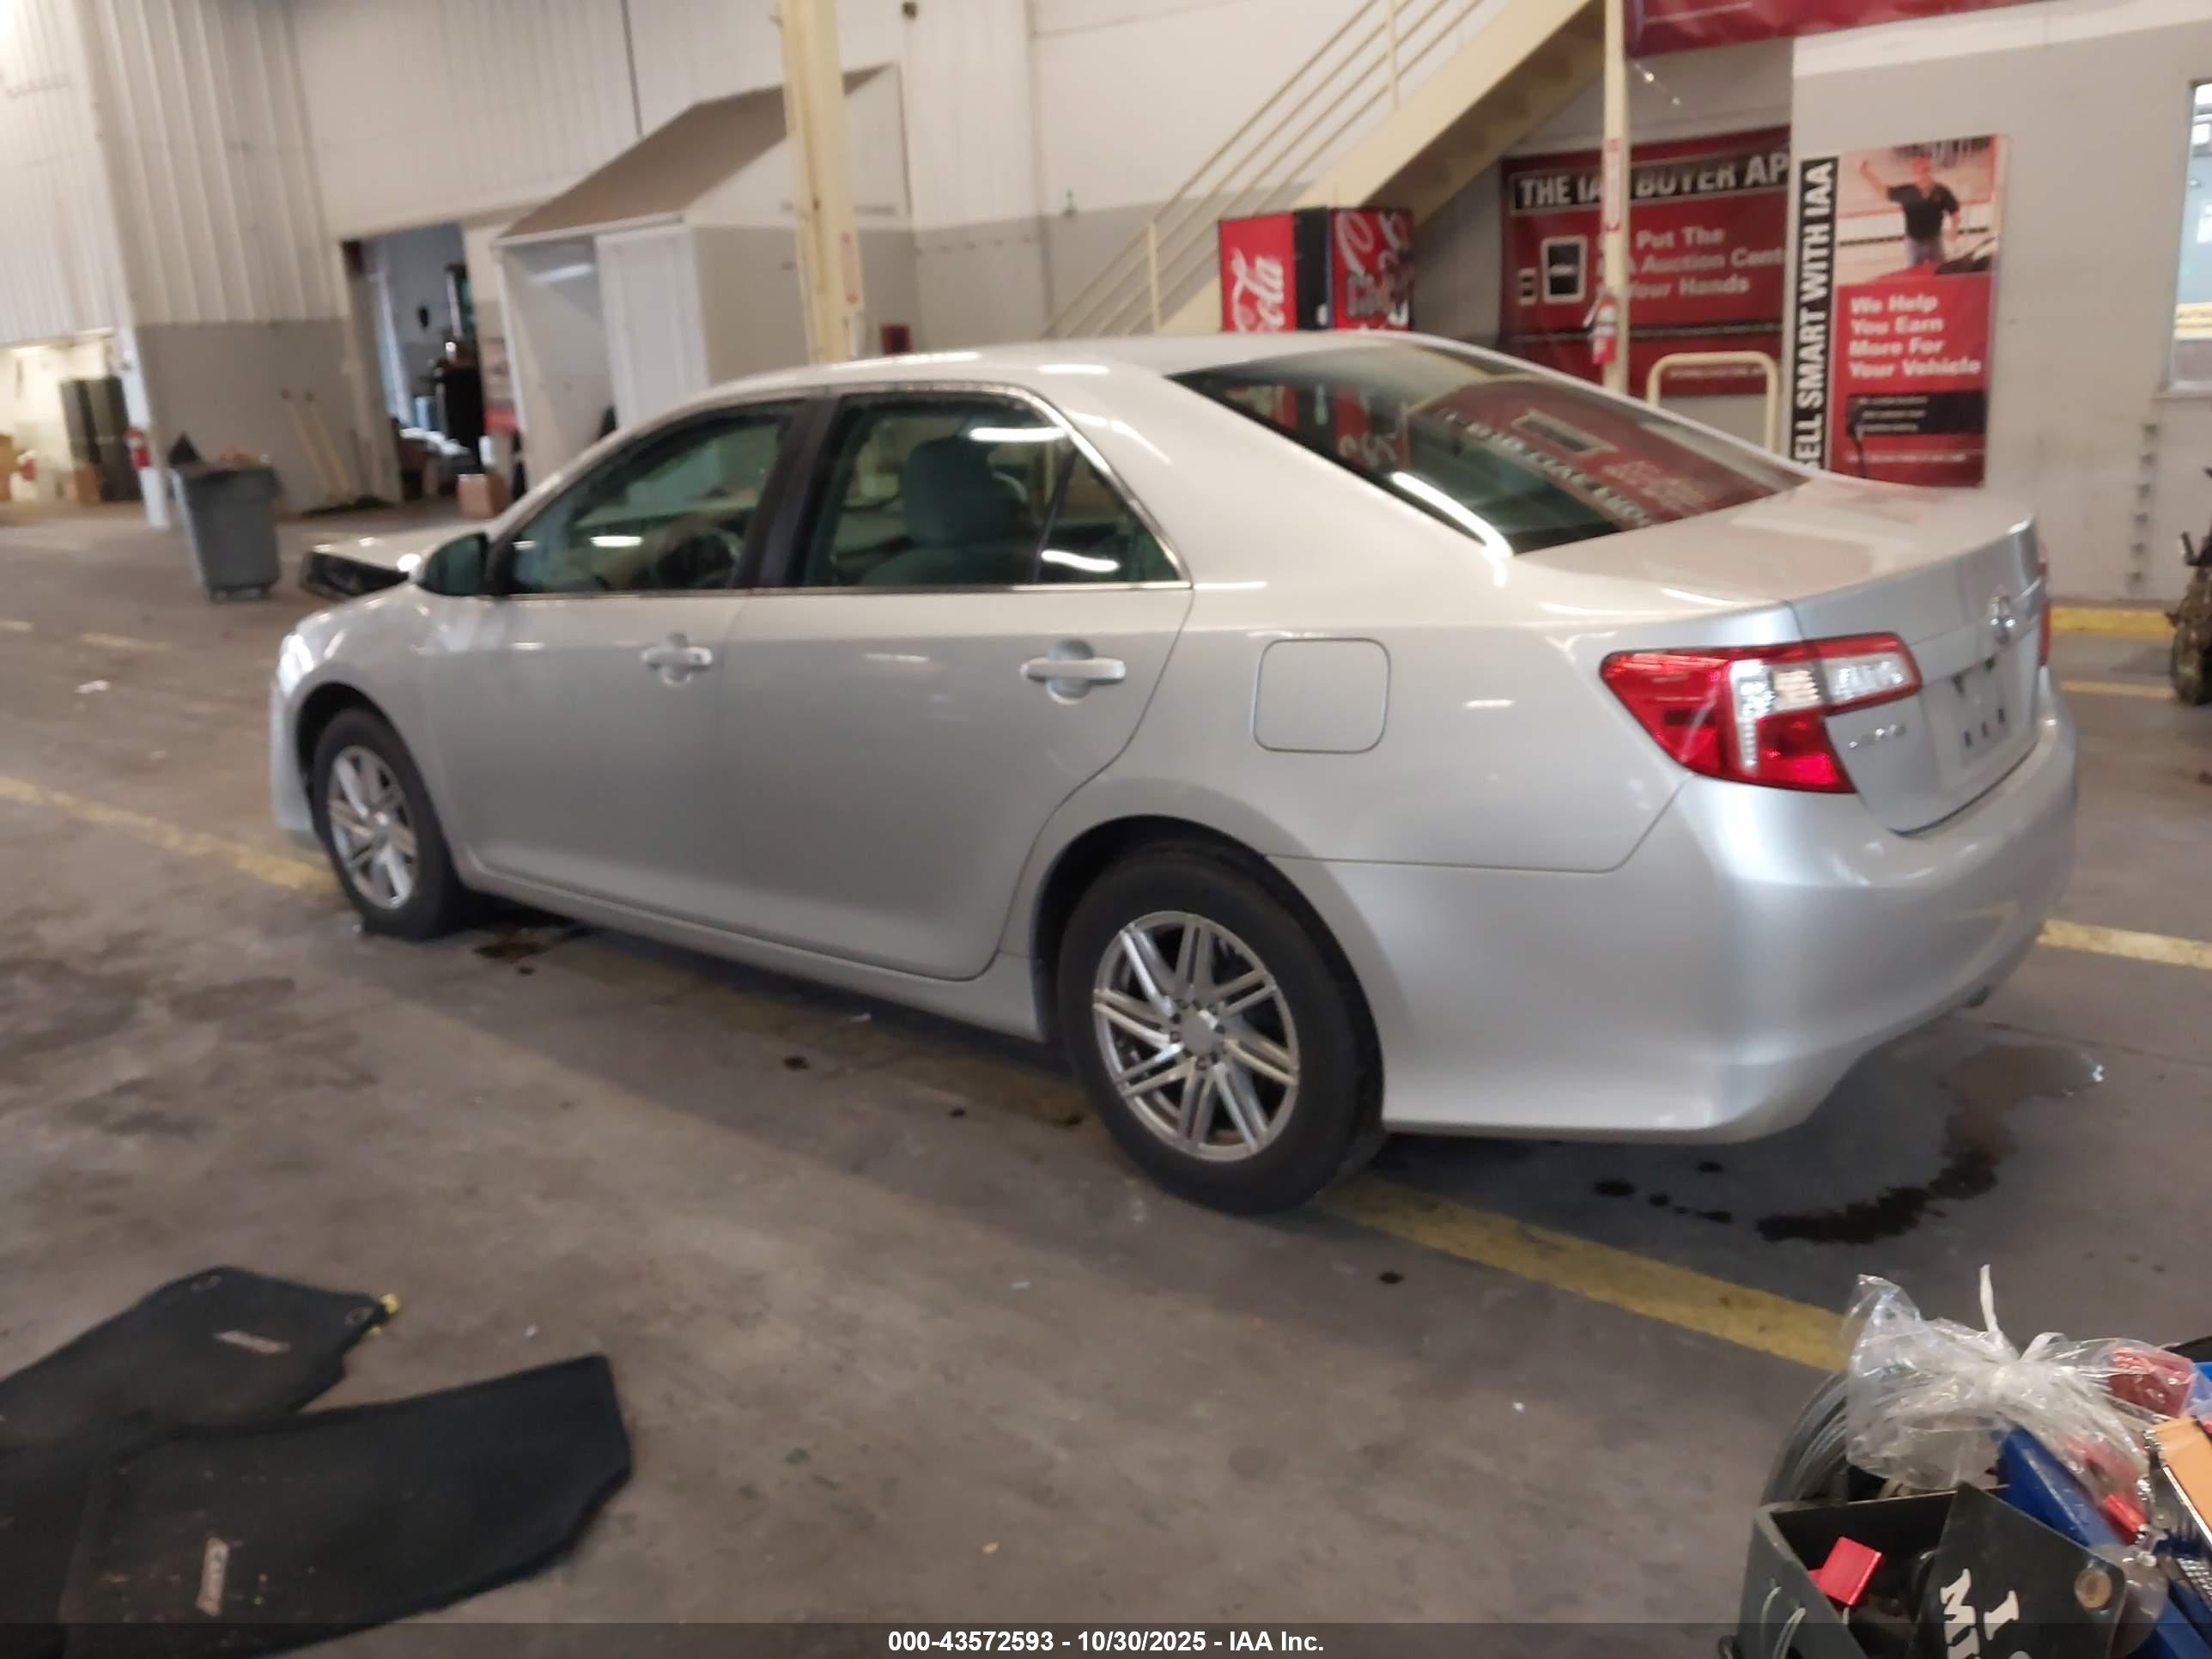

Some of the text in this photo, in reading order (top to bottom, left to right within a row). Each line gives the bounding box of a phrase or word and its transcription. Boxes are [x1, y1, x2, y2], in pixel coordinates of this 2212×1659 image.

[1520, 175, 1571, 205] THE
[1804, 161, 1832, 216] IAA
[1800, 222, 1830, 302] WITH
[1679, 273, 1750, 295] Hands
[1851, 294, 1938, 314] We Help
[1850, 315, 1944, 335] You Earn
[1796, 306, 1826, 409] SMART
[1849, 337, 1945, 356] More For
[1849, 356, 1982, 378] Your Vehicle
